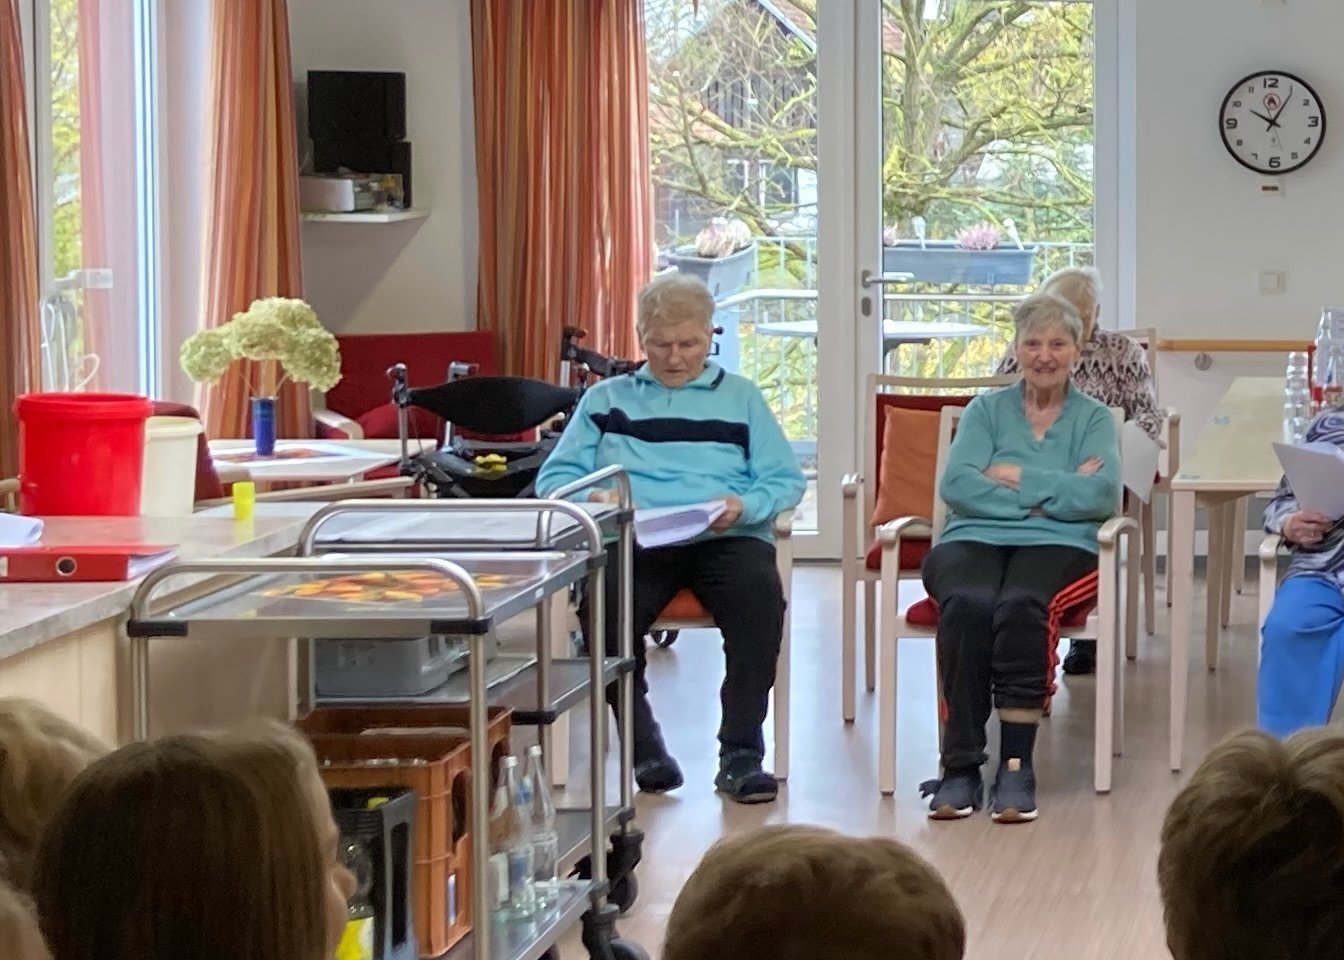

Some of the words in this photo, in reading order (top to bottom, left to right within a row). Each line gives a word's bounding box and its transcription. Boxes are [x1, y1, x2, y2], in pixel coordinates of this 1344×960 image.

[1263, 78, 1279, 88] 12
[1226, 118, 1238, 129] 9
[1308, 116, 1319, 128] 3
[1268, 156, 1281, 168] 6
